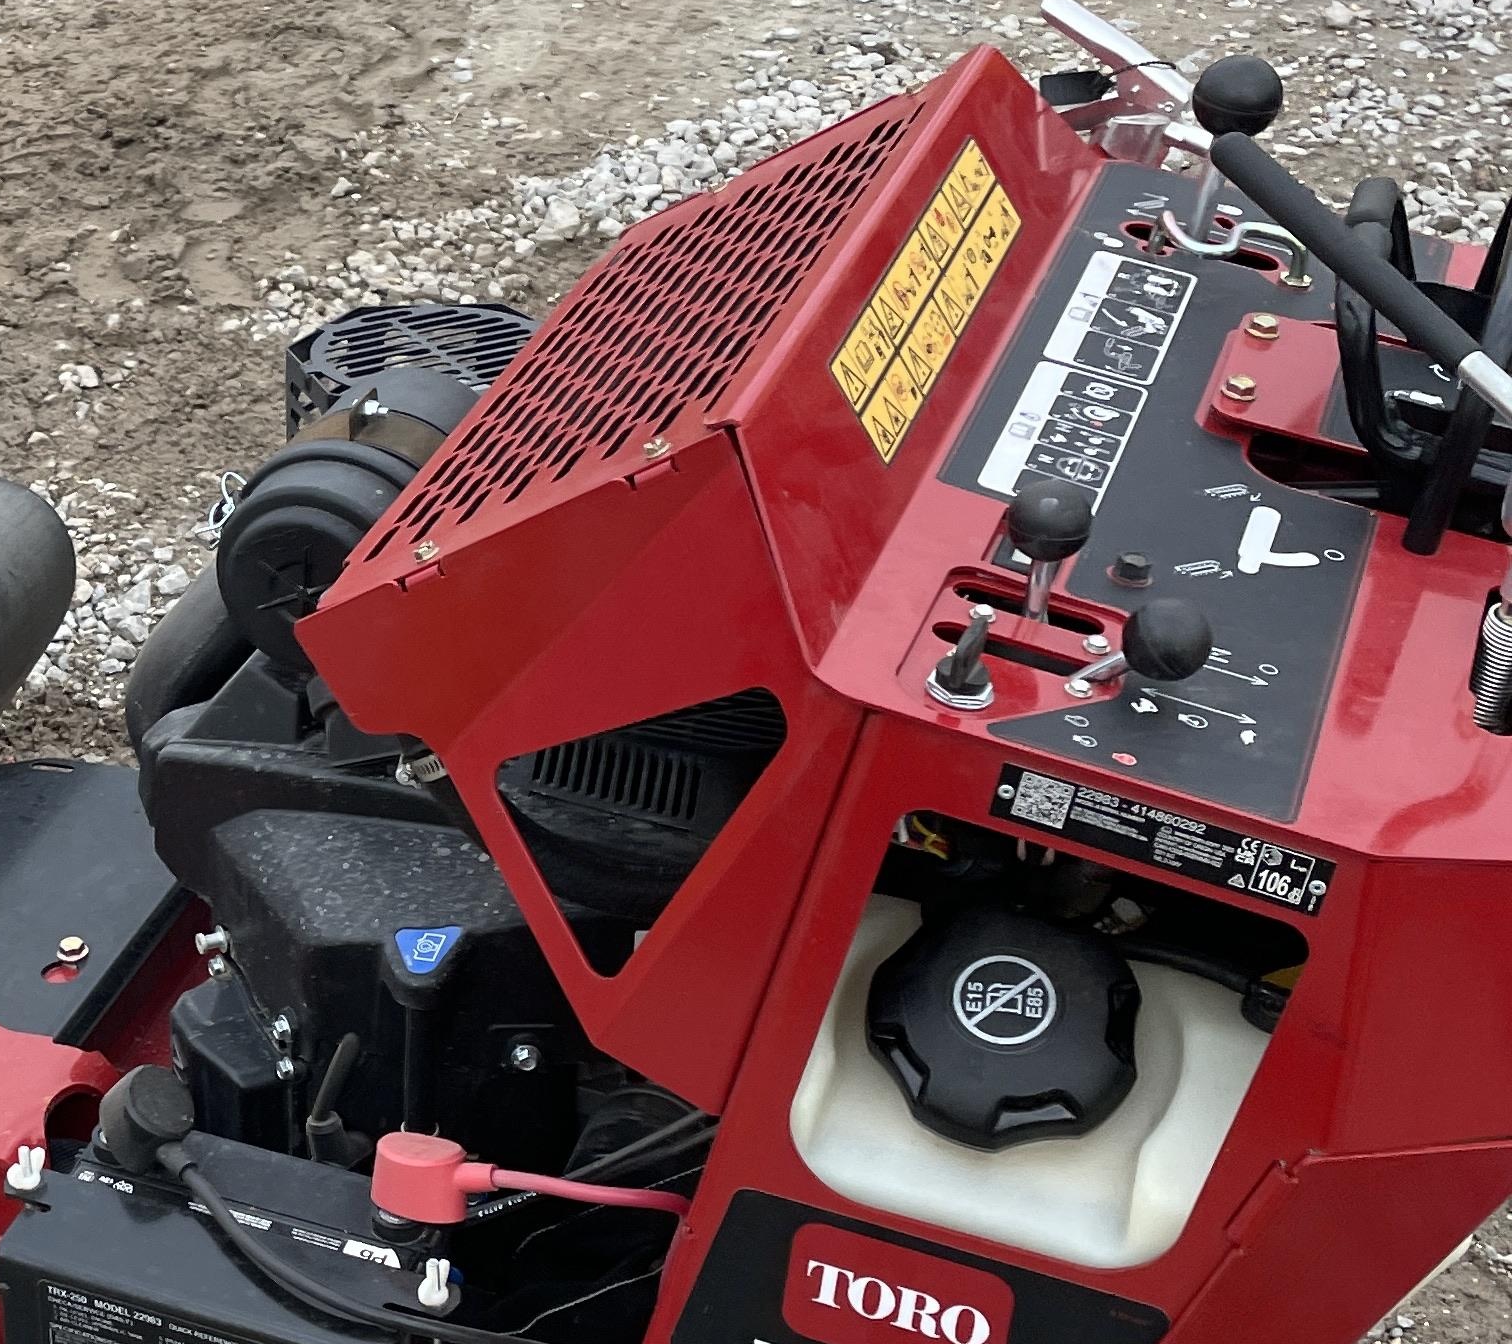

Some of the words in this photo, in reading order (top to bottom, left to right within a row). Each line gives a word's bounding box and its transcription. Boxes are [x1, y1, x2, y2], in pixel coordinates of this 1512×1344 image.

[1258, 869, 1292, 896] 106
[965, 981, 984, 1012] E15
[1025, 987, 1044, 1018] E85
[94, 1299, 131, 1319] MODEL
